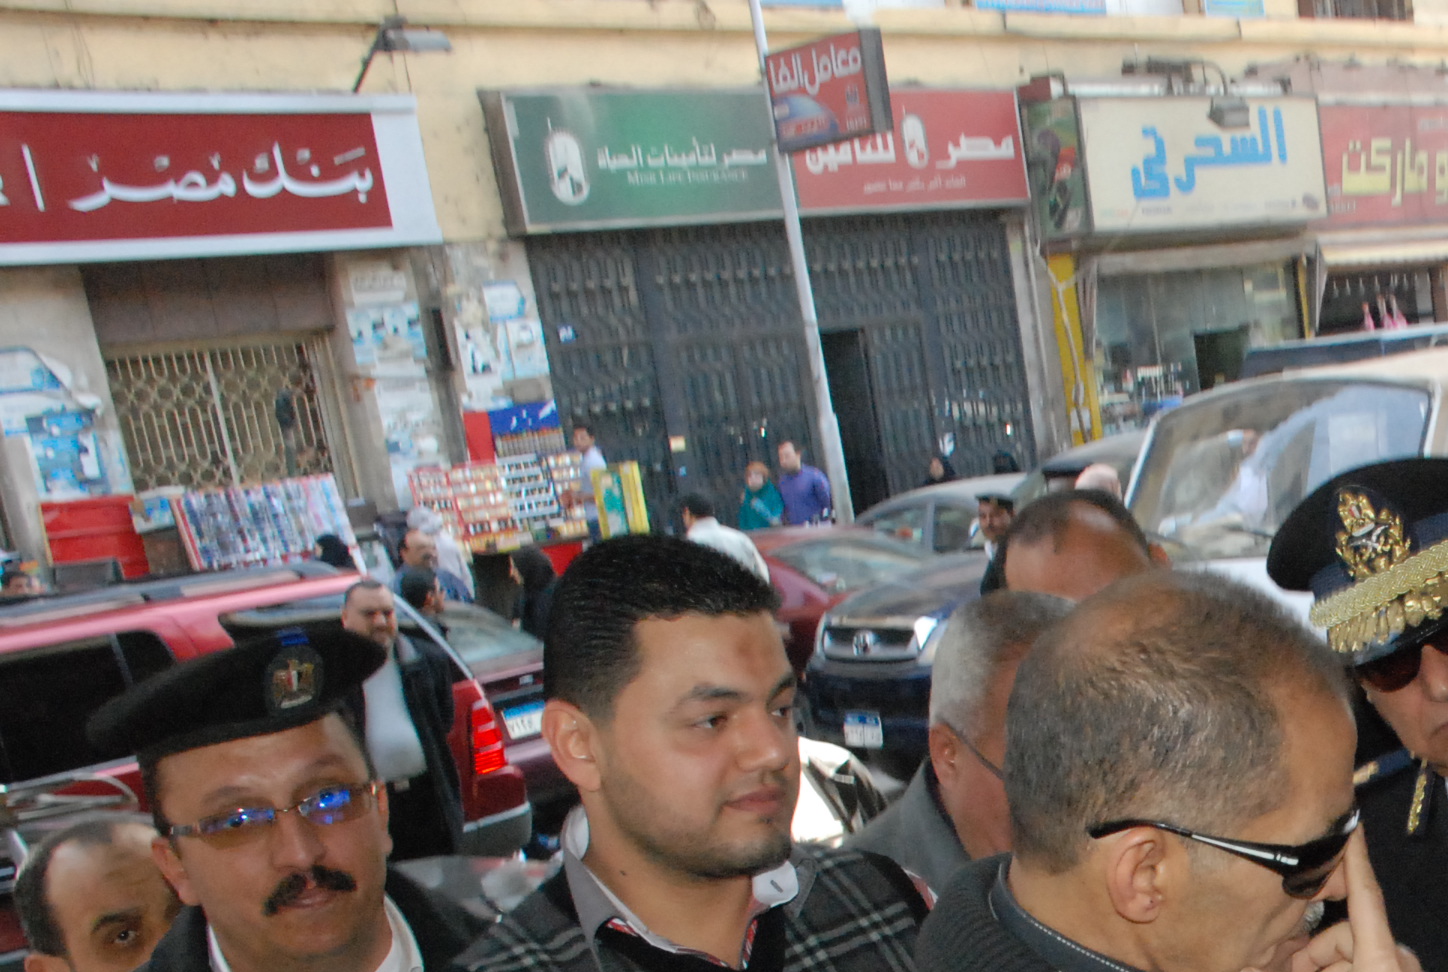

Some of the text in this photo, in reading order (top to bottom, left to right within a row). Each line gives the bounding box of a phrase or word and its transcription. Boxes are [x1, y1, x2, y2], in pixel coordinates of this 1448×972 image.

[804, 43, 862, 97] معامل
[723, 149, 768, 169] مصر
[936, 132, 1015, 170] مصر
[1341, 137, 1429, 207] ماركت
